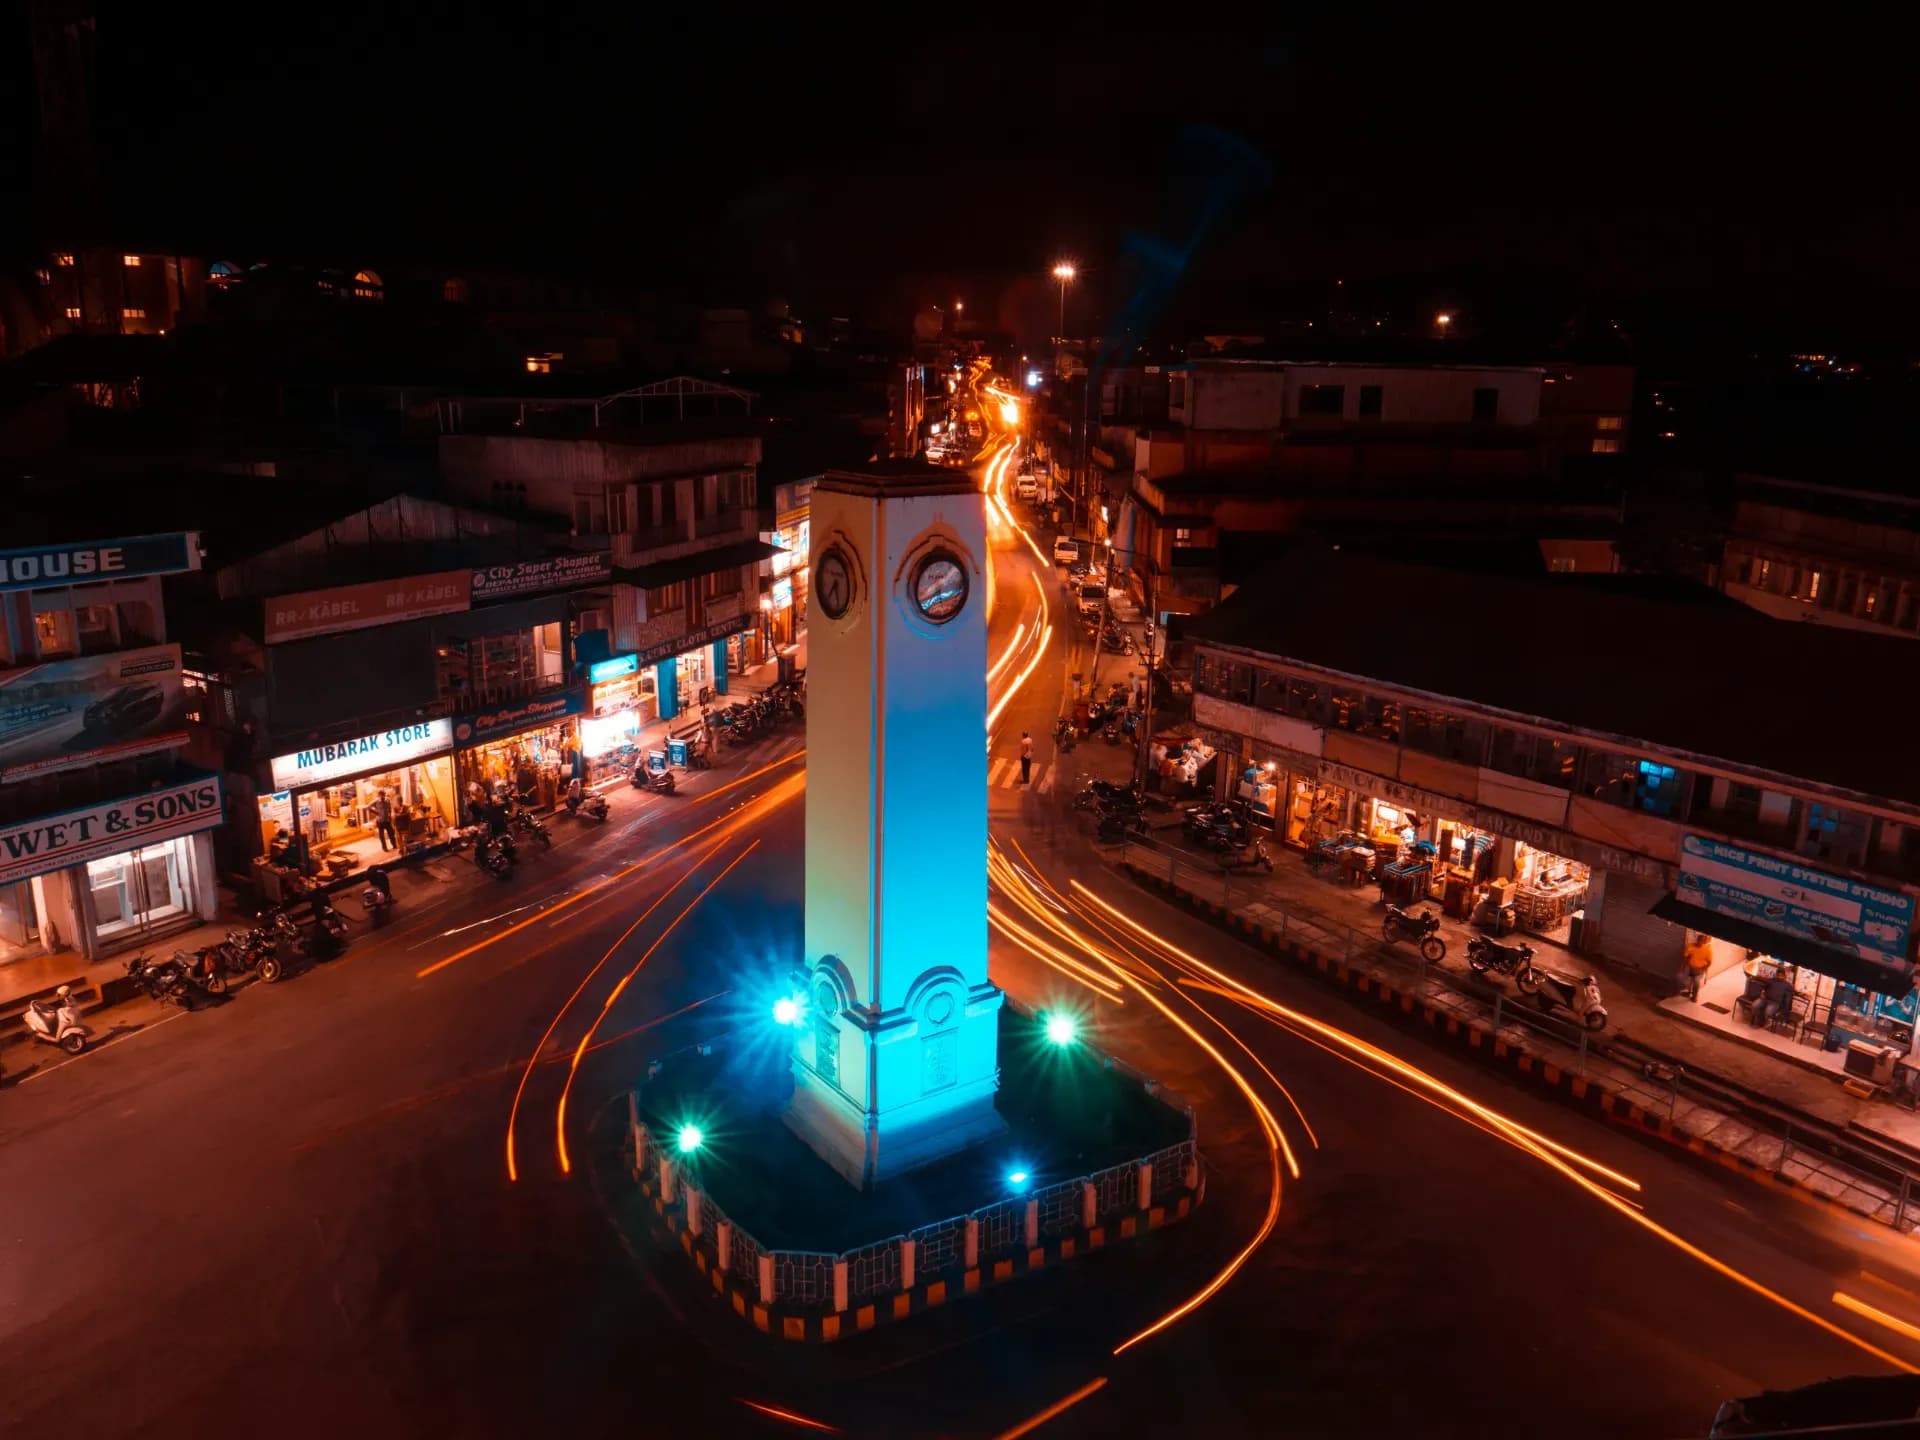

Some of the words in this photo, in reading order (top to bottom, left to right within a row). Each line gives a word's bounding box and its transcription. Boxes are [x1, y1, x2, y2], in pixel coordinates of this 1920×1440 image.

[275, 610, 297, 626] RR
[297, 735, 380, 769] MUBARAK
[386, 723, 431, 747] STORE
[0, 815, 98, 860] WET
[105, 808, 134, 834] &
[135, 785, 216, 827] SONS
[1714, 846, 1746, 863] NICE
[1747, 855, 1789, 875] PRINT
[1792, 867, 1848, 893] SYSTEM
[1850, 885, 1909, 909] STUDIO
